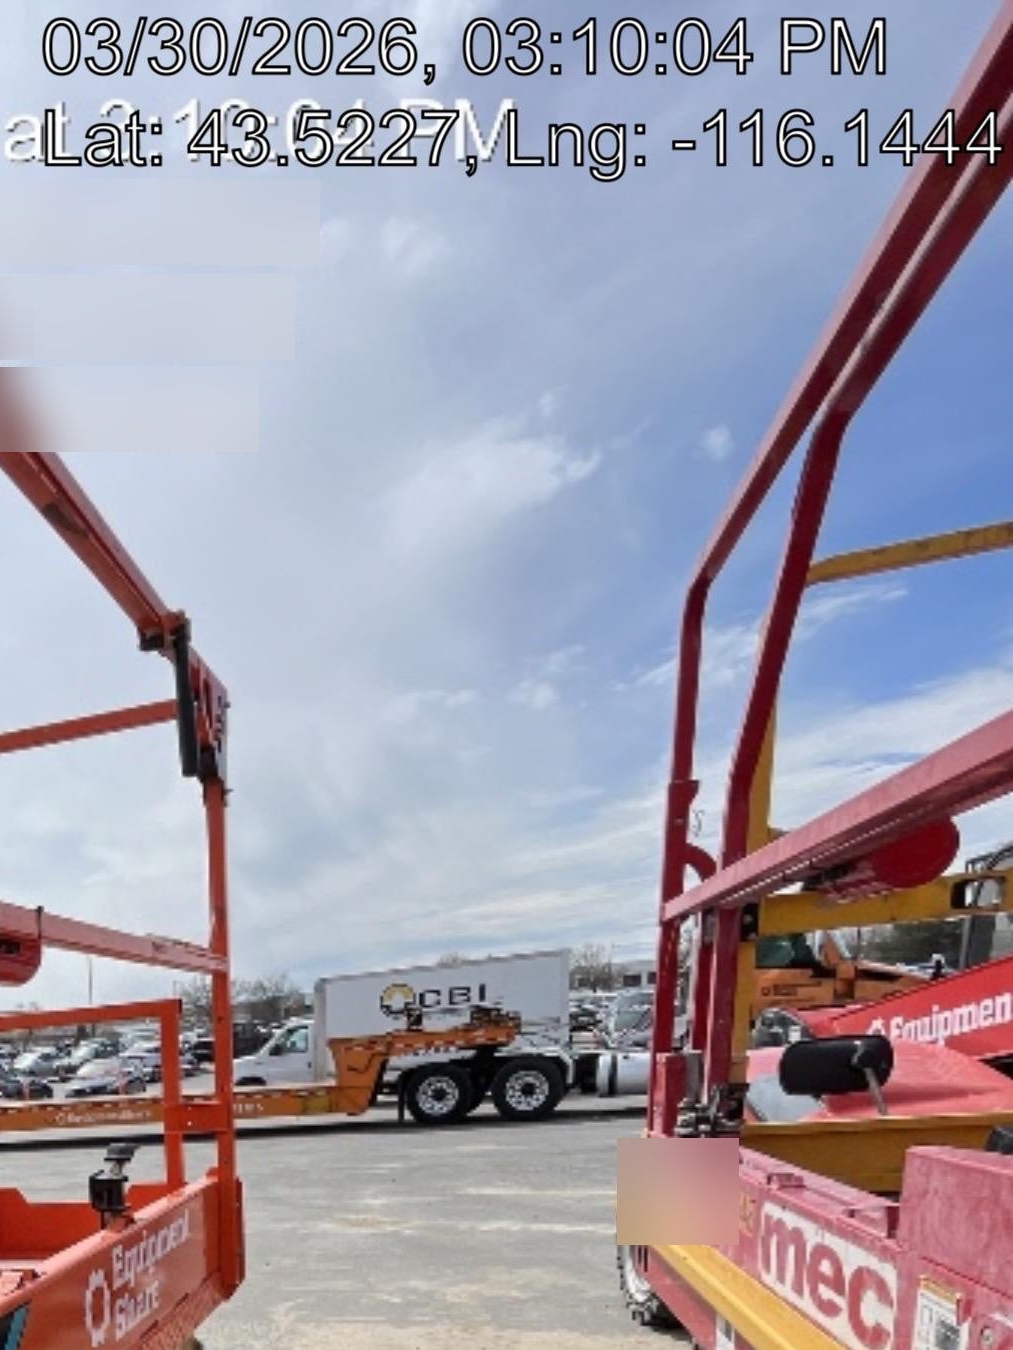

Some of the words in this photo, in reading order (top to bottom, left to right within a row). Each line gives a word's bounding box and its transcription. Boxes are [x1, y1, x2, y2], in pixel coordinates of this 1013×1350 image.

[419, 983, 487, 1008] CBI
[889, 991, 1013, 1046] Equipmen
[761, 1203, 894, 1350] mec
